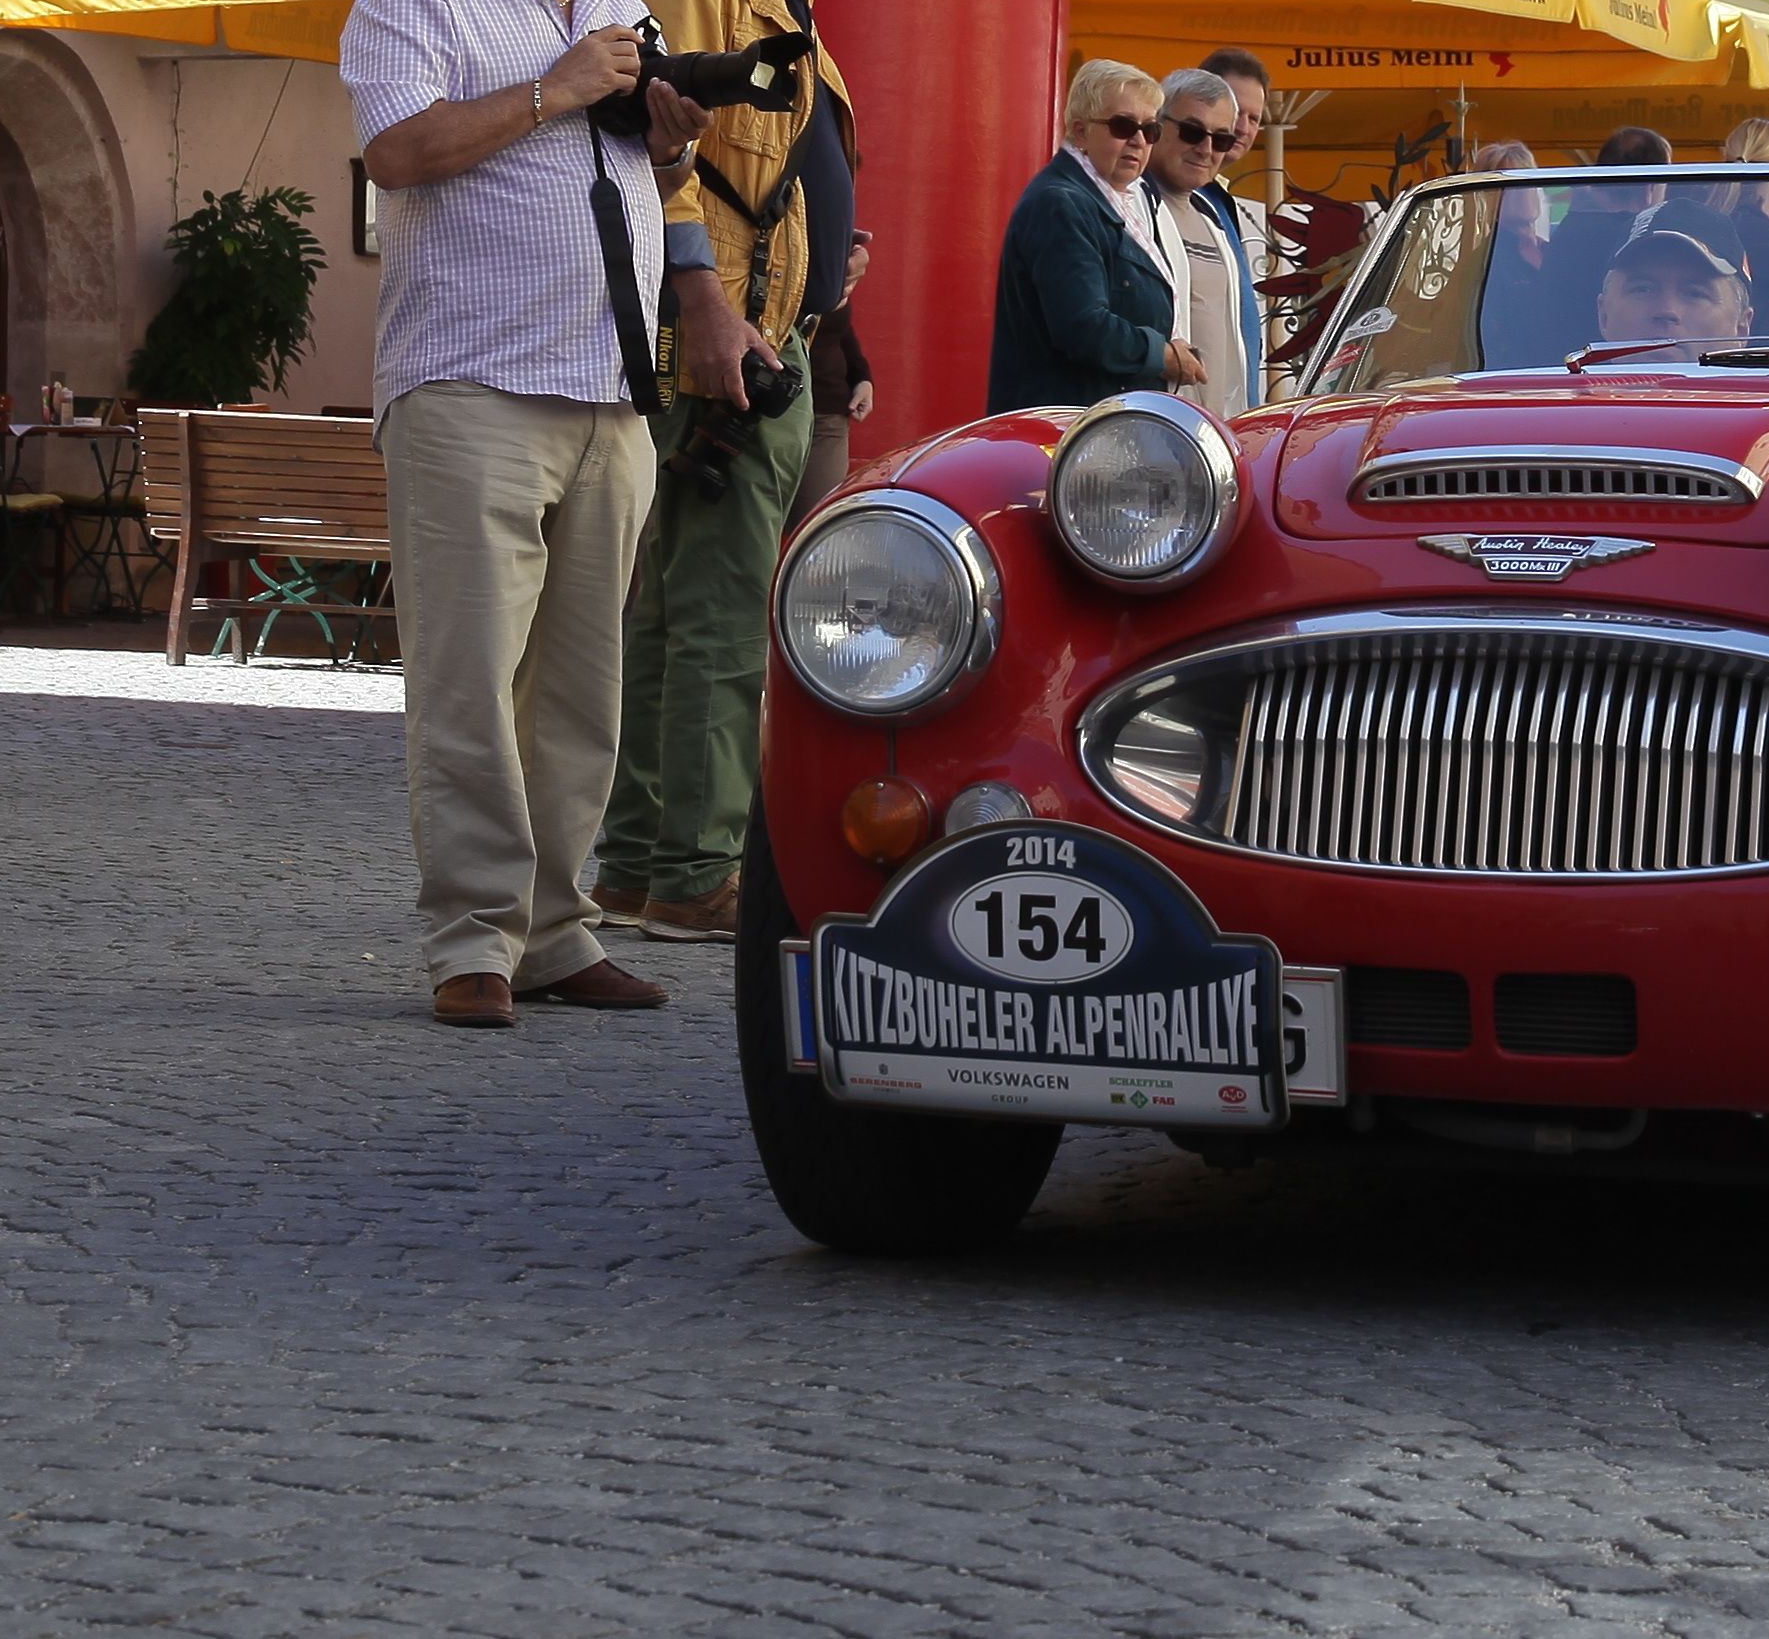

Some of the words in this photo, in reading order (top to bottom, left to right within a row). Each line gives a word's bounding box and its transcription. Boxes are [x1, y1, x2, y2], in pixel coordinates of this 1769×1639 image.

[1472, 537, 1523, 551] Austin
[1533, 537, 1591, 554] Healey
[1005, 836, 1076, 869] 2014
[974, 891, 1107, 965] 154
[834, 944, 1036, 1054] KITZBÜHELER
[1046, 967, 1260, 1067] ALPENRALLYE
[947, 1068, 1070, 1091] VOLKSWAGEN
[991, 1093, 1029, 1105] GROUP
